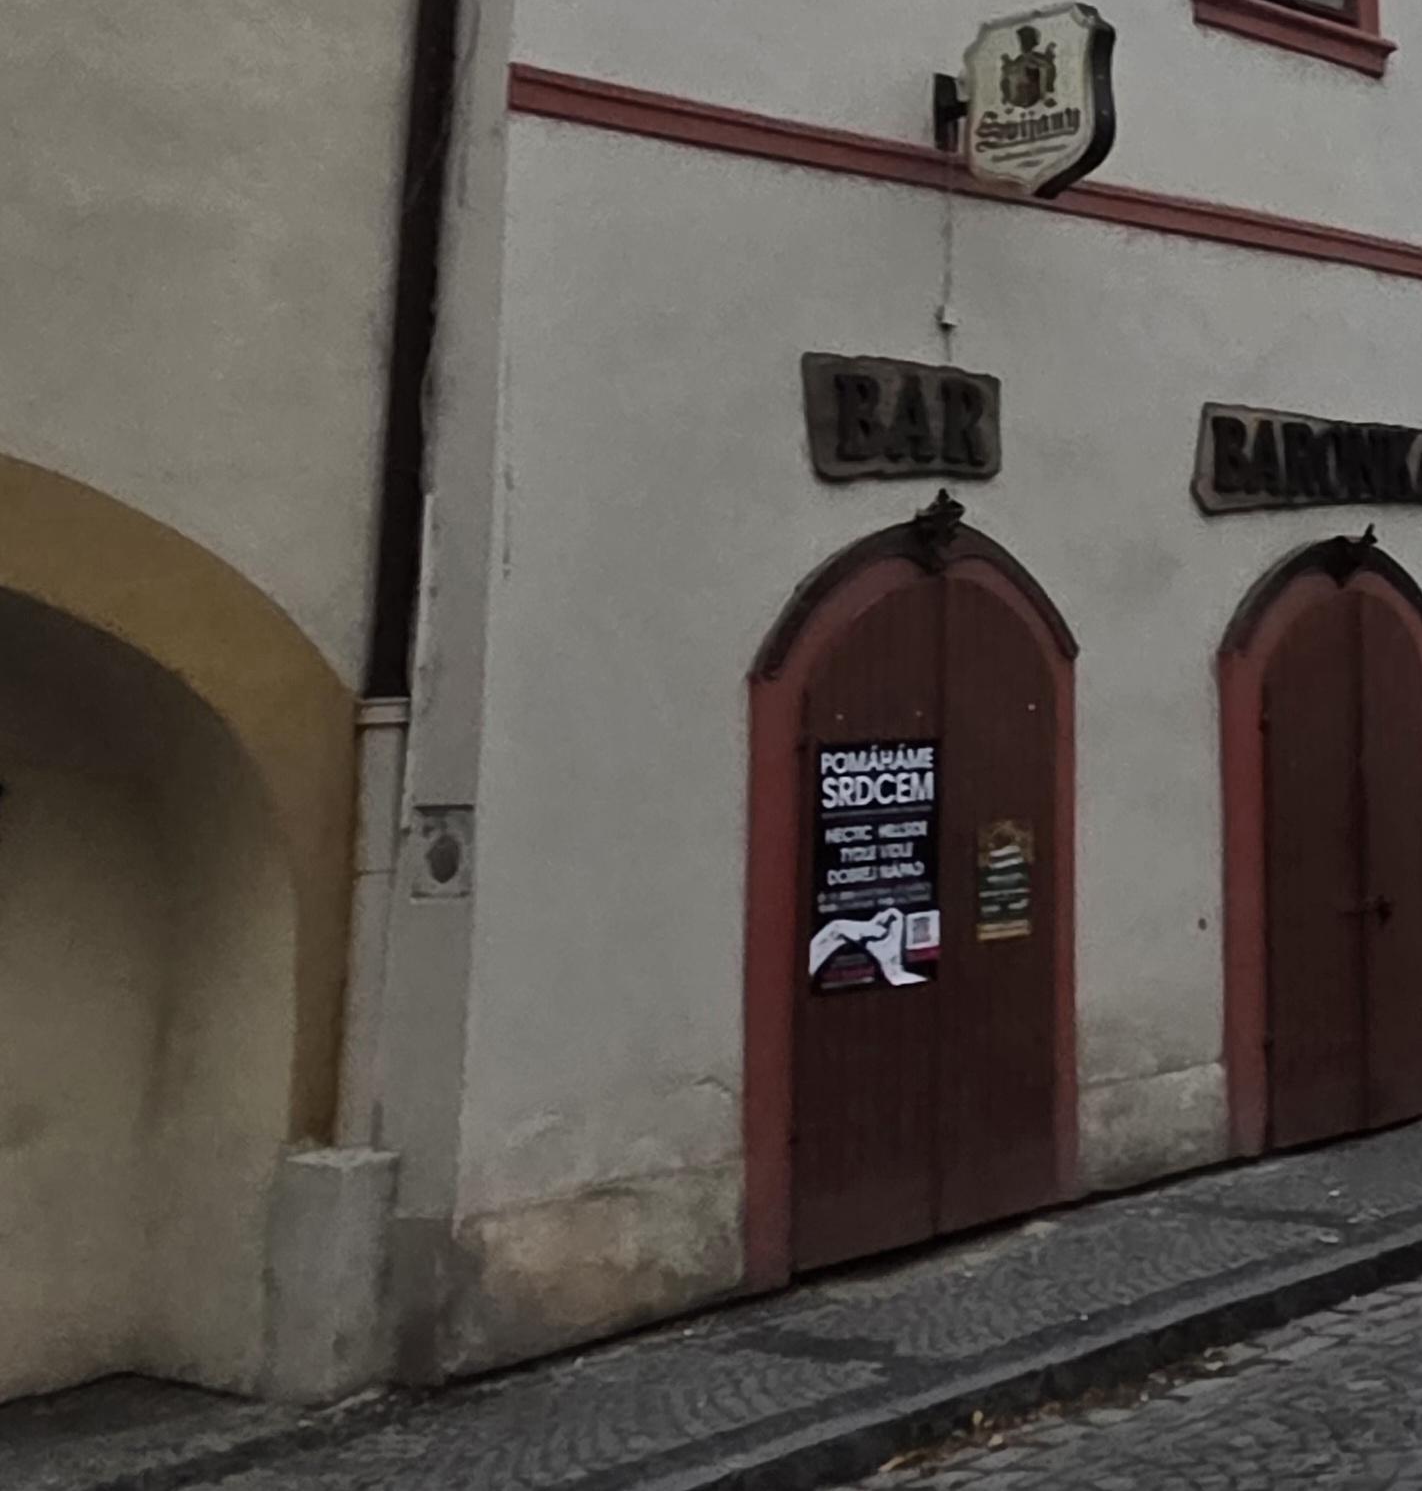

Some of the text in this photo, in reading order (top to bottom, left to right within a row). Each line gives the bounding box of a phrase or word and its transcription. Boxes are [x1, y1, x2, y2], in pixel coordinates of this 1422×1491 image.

[834, 373, 986, 466] BAR
[820, 743, 935, 775] POMÁHÁME
[821, 771, 935, 809] SRDCEM
